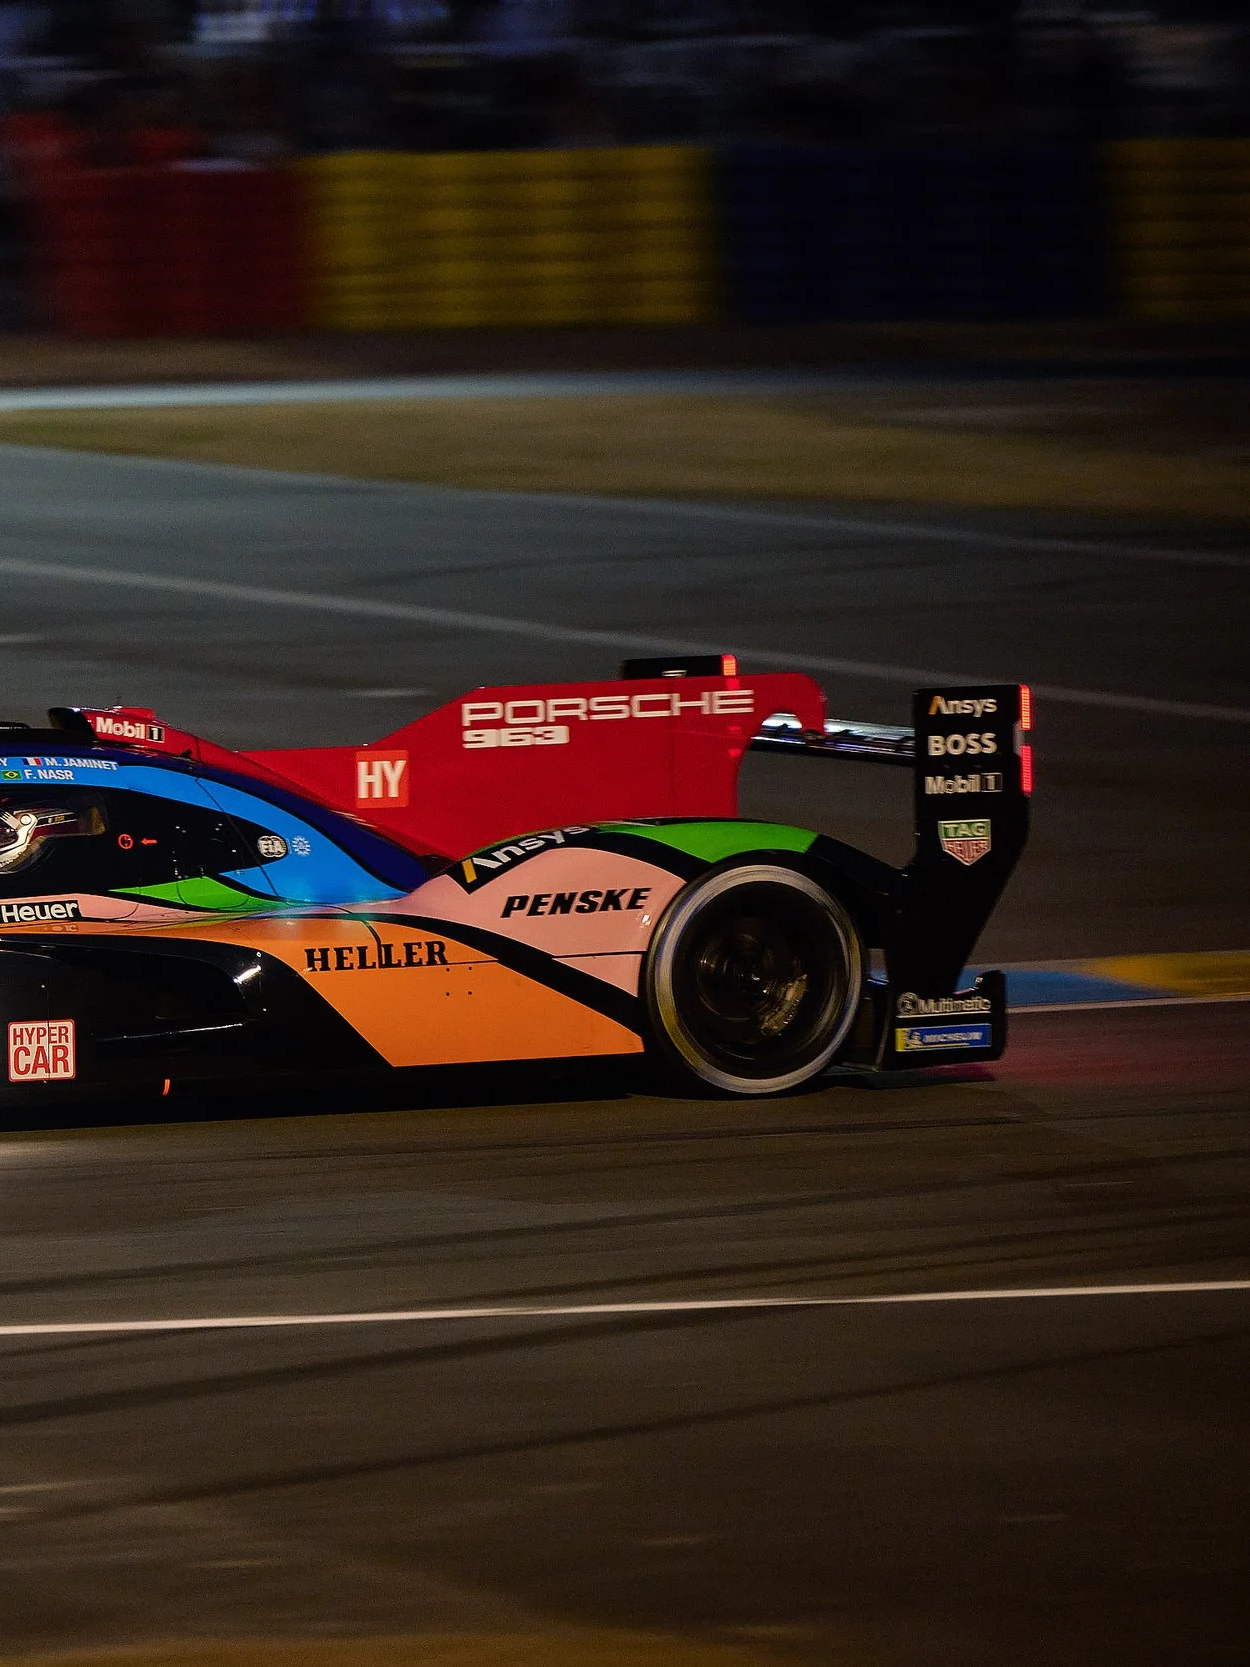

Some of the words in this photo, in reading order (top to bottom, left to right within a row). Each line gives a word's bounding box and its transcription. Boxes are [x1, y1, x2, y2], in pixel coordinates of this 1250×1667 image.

[461, 690, 754, 727] PORSCHE
[928, 695, 997, 717] Ansys
[96, 716, 146, 740] Mobil
[462, 725, 570, 748] 963
[928, 732, 997, 756] BOSS
[24, 769, 37, 779] F.
[39, 769, 74, 781] NASR
[60, 758, 118, 771] JAMINET
[358, 760, 407, 799] HY
[925, 774, 981, 795] Mobil
[944, 822, 987, 837] TAG
[461, 826, 590, 883] Ansys
[500, 887, 652, 918] PENSKE
[304, 940, 448, 972] HELLER
[12, 1025, 70, 1046] HYPER
[13, 1045, 70, 1075] CAR
